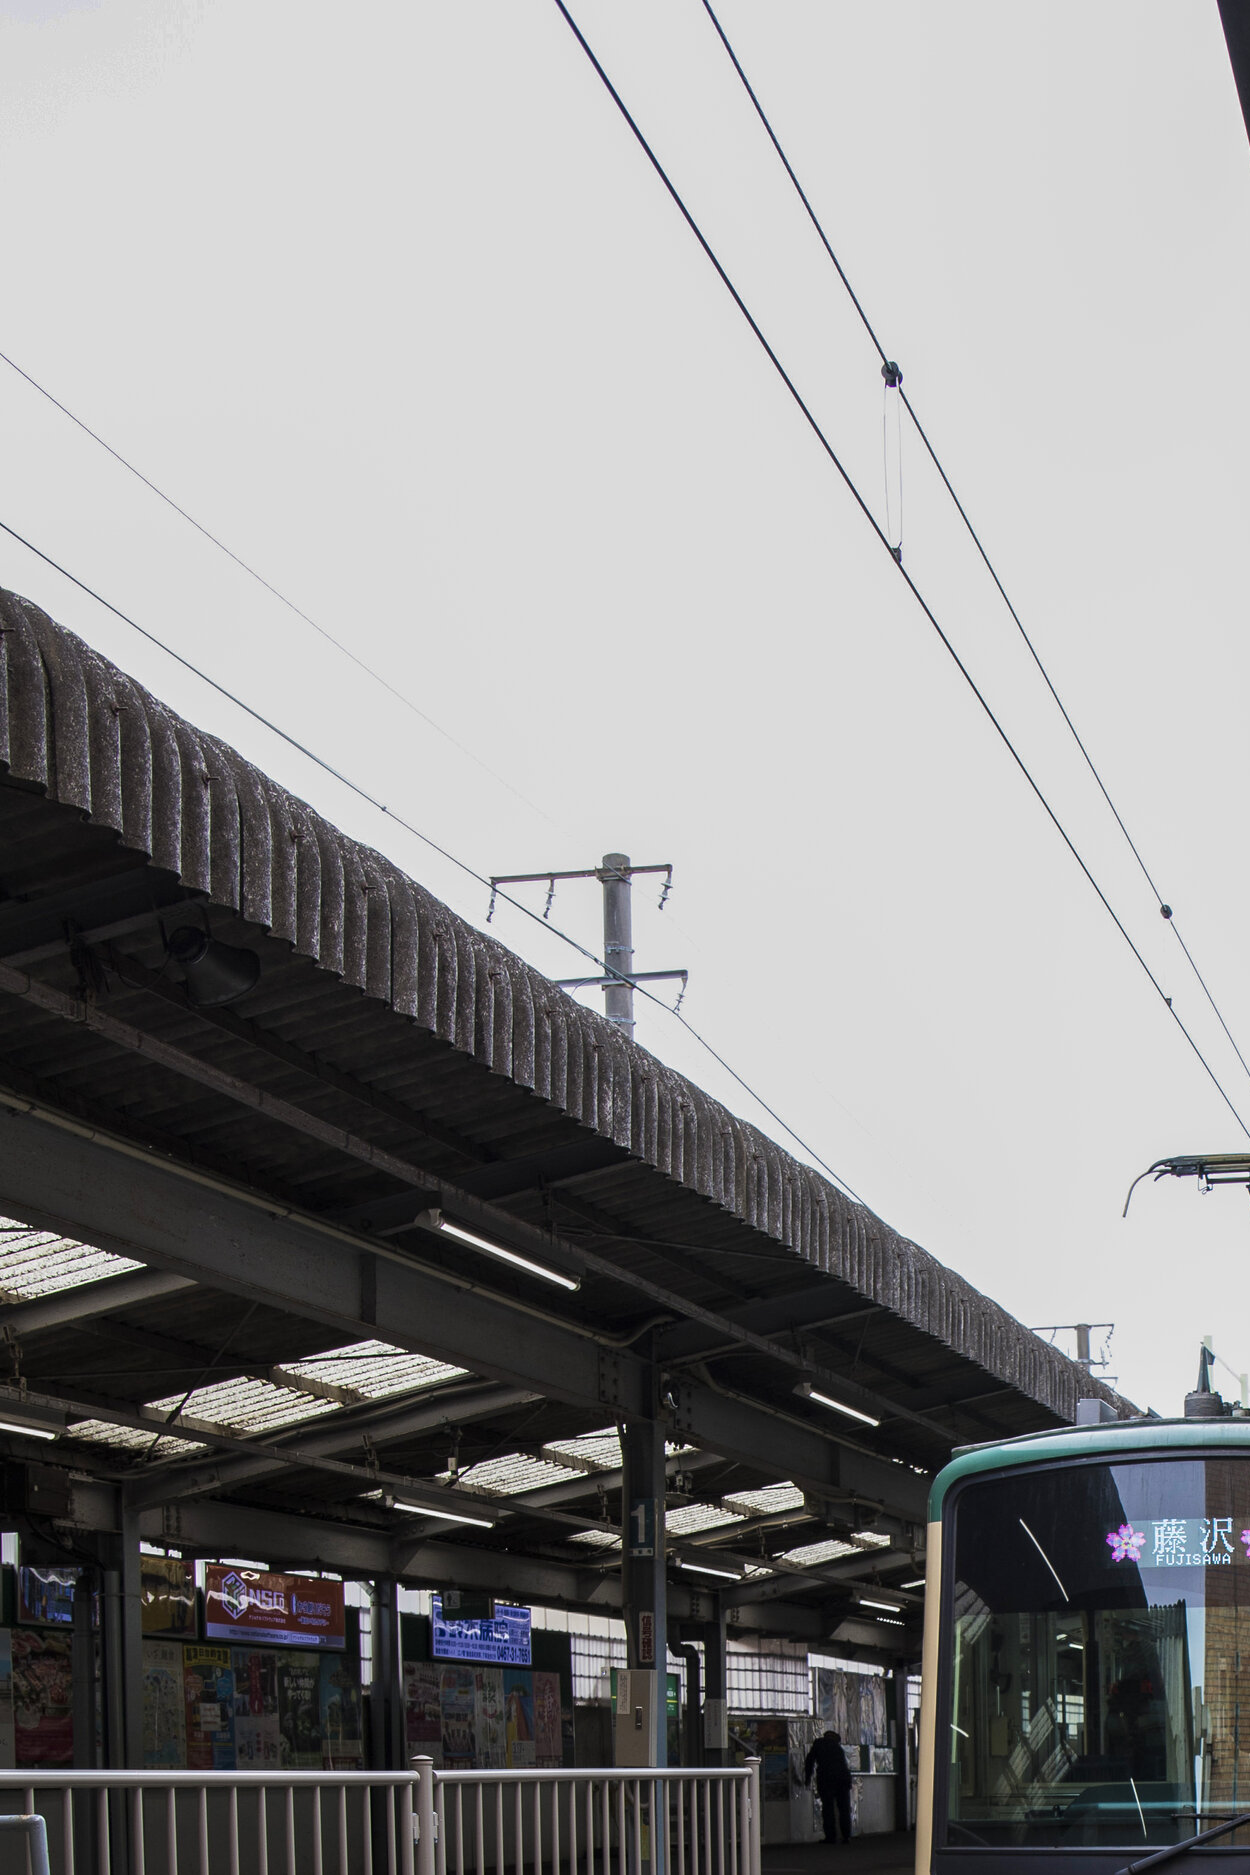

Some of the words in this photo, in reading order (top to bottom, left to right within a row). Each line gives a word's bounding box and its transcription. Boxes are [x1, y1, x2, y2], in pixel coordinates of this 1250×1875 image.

[630, 1504, 646, 1544] 1
[1152, 1517, 1235, 1554] 藤沢
[1156, 1553, 1231, 1566] FUJISAWA
[249, 1589, 285, 1611] NSG
[641, 1615, 653, 1661] 信号確認
